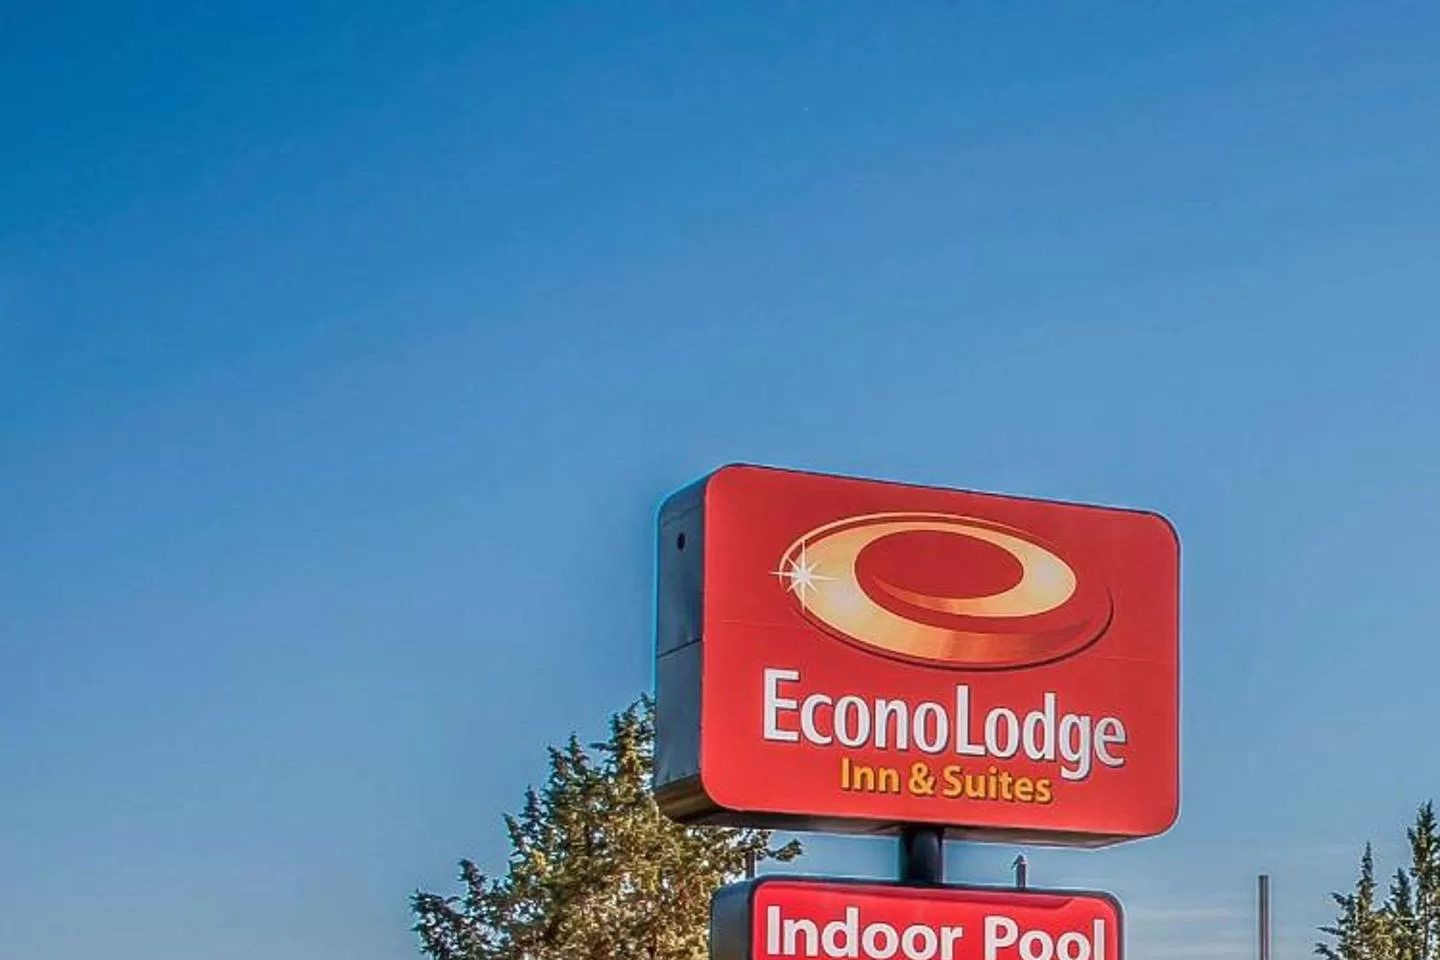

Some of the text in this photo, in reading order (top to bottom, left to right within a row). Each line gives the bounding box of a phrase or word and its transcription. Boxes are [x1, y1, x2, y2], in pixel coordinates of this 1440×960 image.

[840, 757, 1053, 803] Inn & Suites
